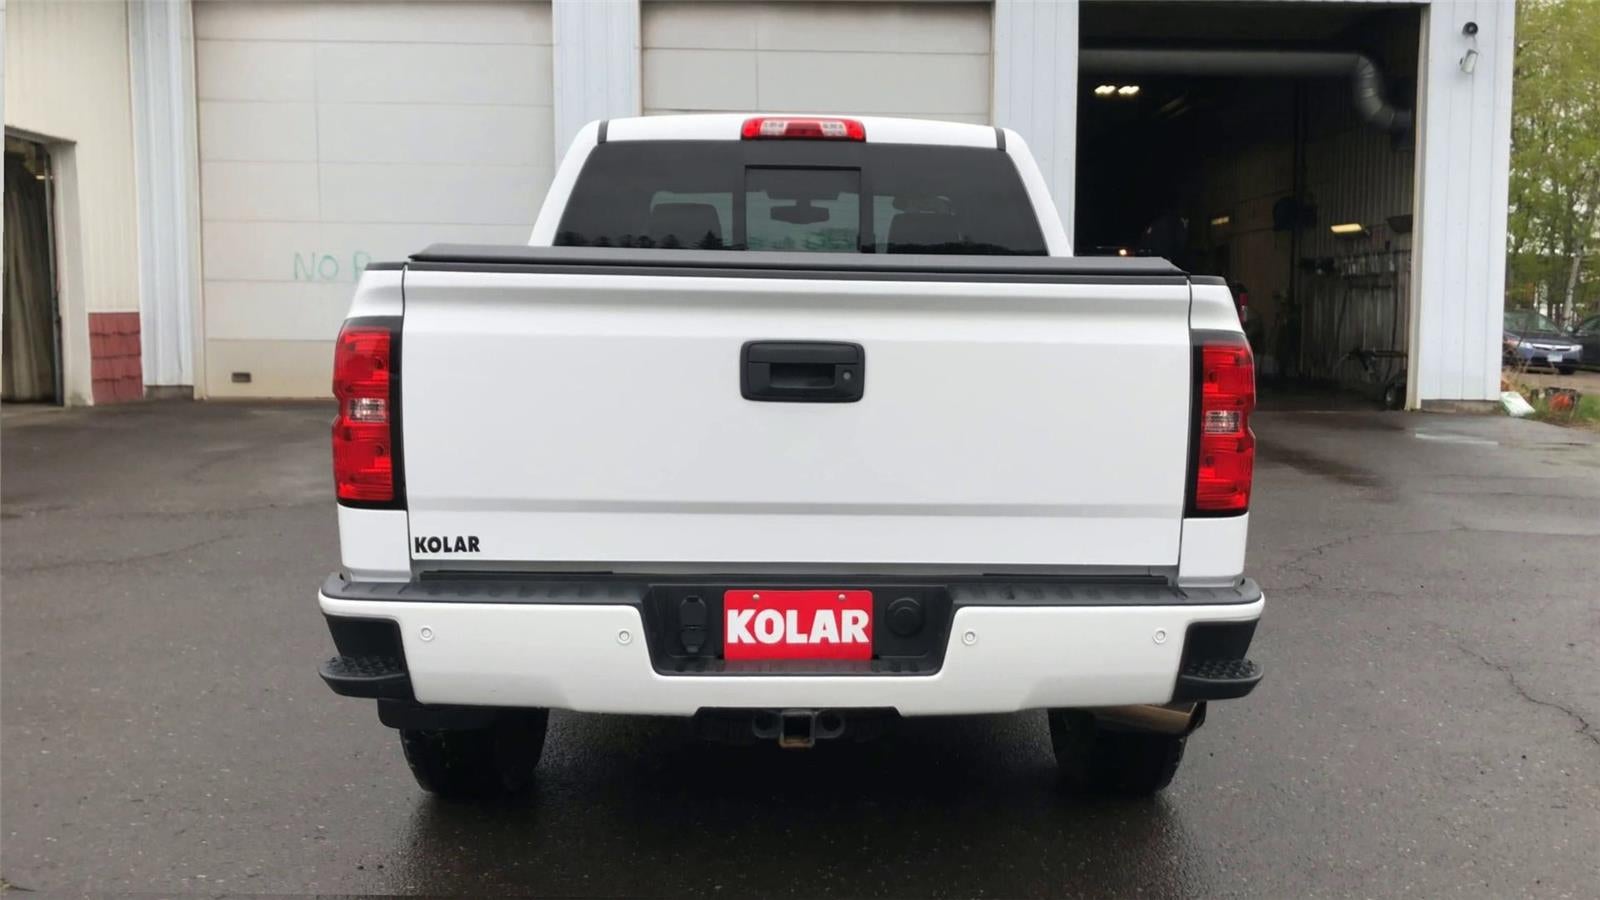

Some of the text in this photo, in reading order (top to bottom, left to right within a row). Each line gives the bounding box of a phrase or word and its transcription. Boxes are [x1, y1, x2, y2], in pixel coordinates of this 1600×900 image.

[294, 251, 339, 281] NO
[414, 535, 481, 553] KOLAR
[727, 608, 870, 644] KOLAR
